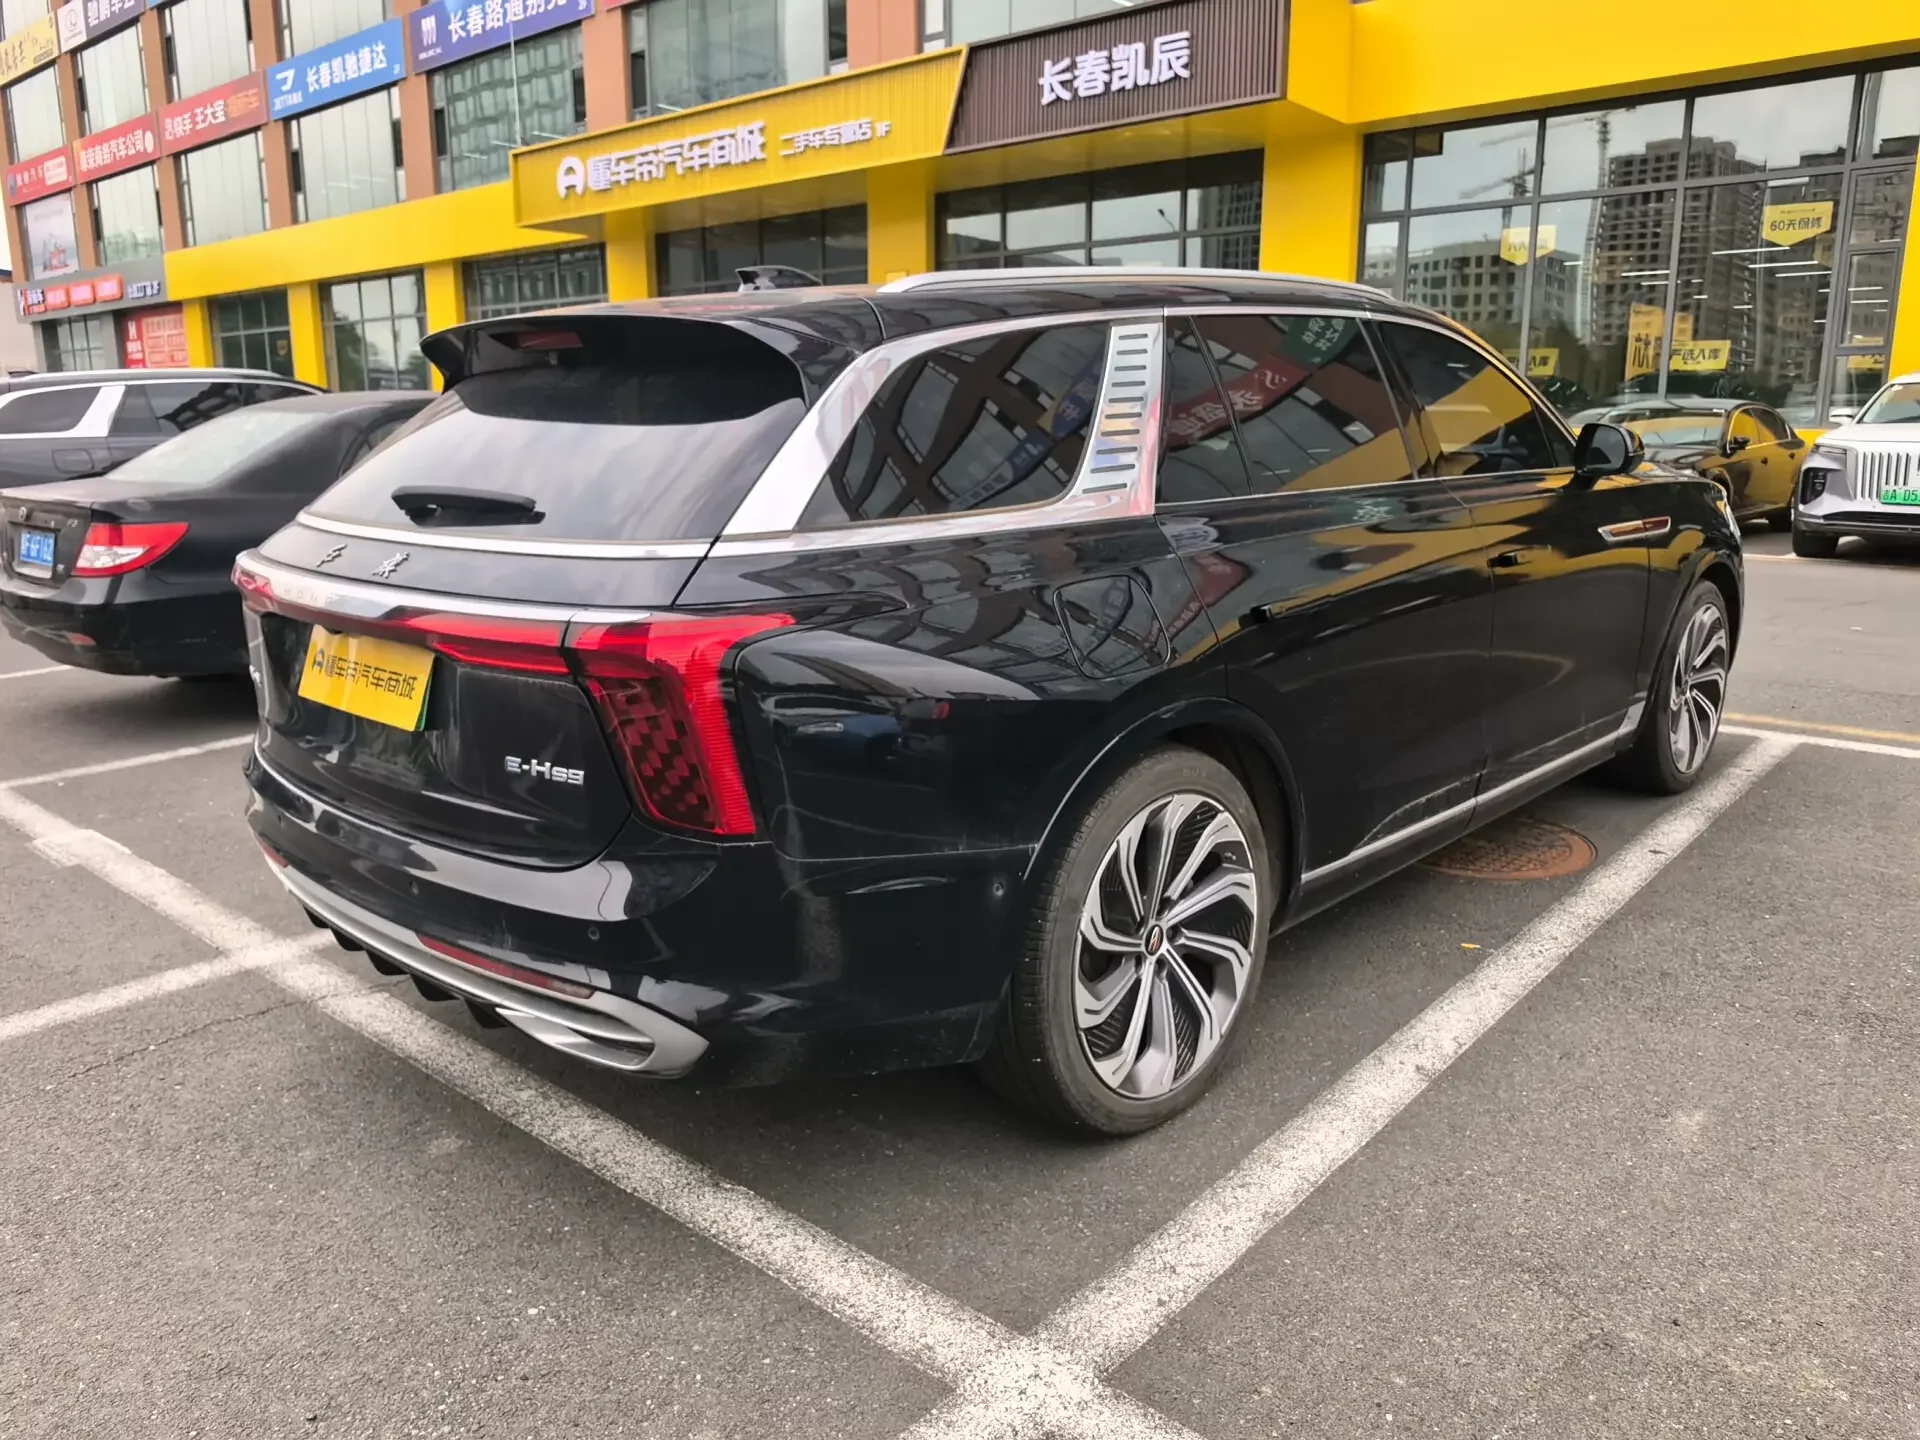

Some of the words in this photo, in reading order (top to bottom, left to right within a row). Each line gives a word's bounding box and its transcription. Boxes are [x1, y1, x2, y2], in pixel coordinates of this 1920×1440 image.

[1038, 30, 1191, 106] 长春凯辰
[1769, 216, 1824, 232] 60天保修
[1903, 489, 1920, 502] D5
[325, 655, 418, 700] 懂车帝汽车商城
[504, 755, 585, 786] E-HS9
